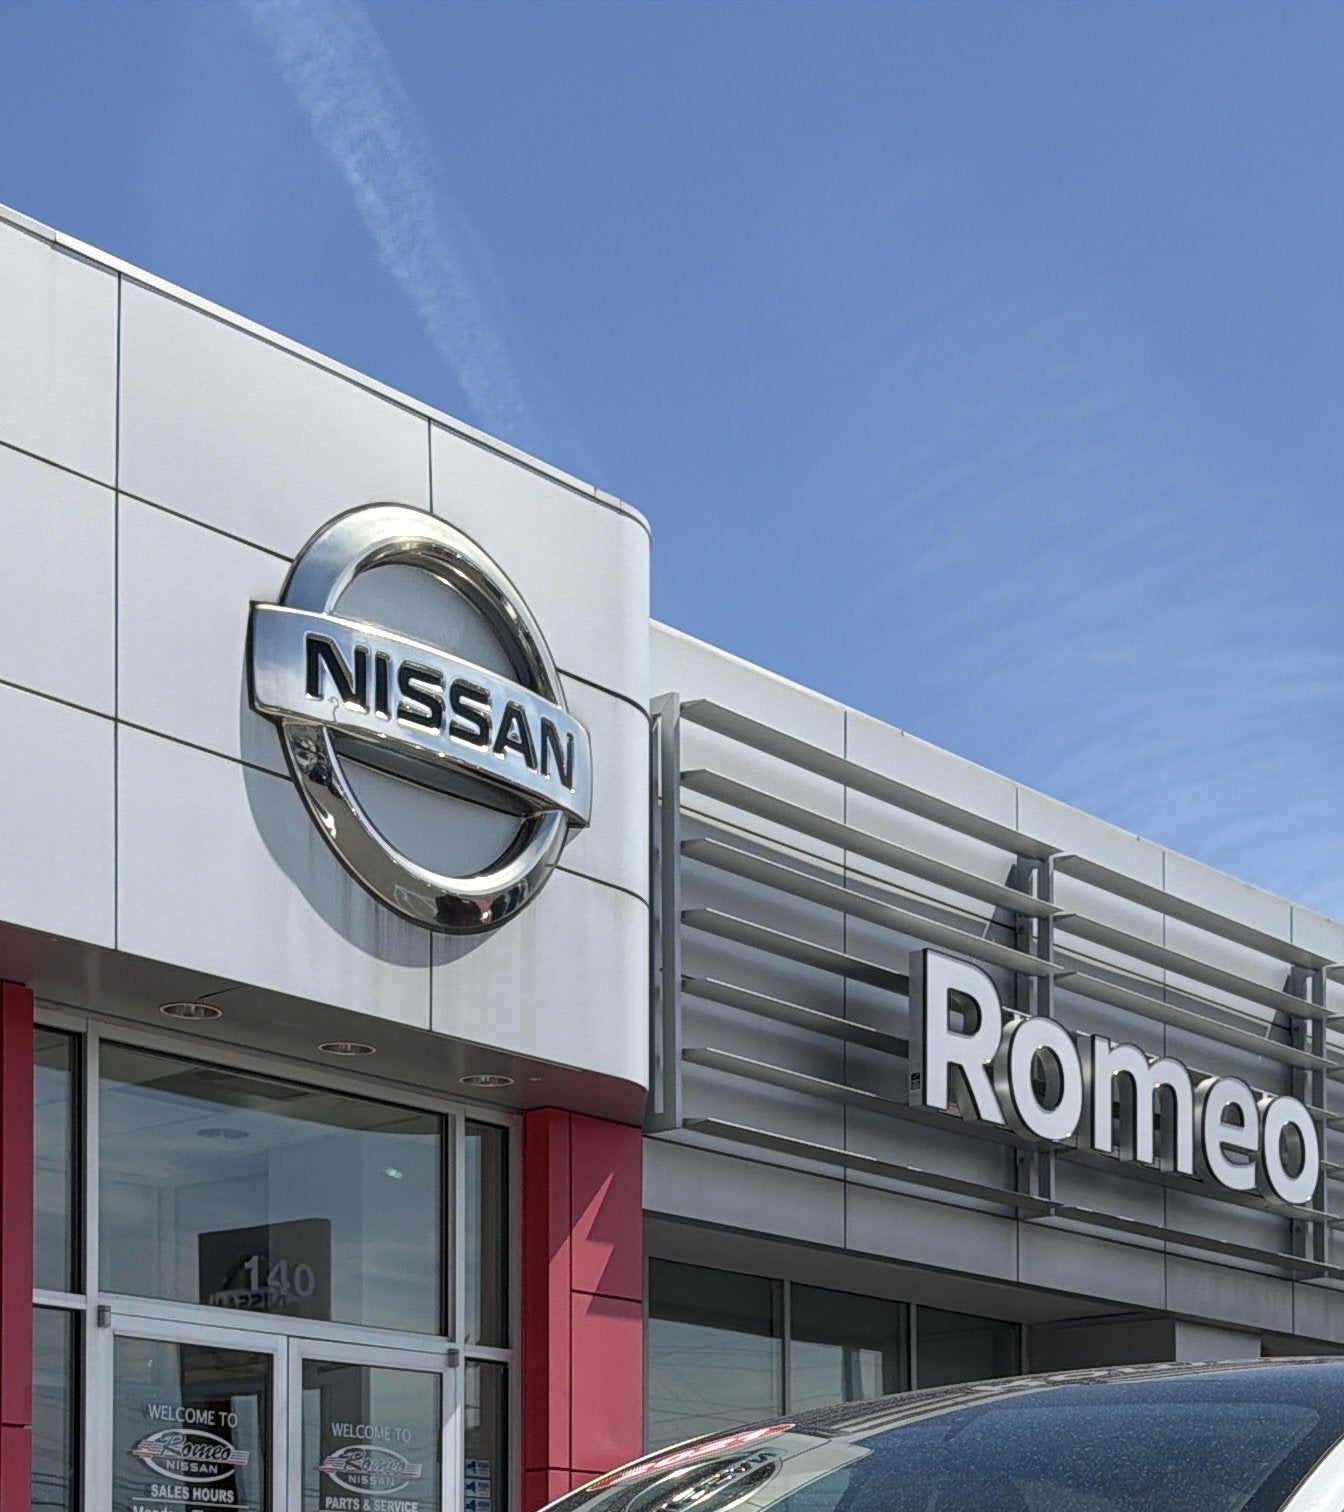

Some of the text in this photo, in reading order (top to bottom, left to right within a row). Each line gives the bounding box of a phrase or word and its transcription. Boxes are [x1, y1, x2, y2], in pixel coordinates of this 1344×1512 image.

[305, 632, 577, 795] NISSAN
[918, 948, 1320, 1204] Romeo
[244, 1255, 316, 1298] 140
[148, 1403, 238, 1428] WELCOME TO
[331, 1422, 411, 1443] WELCOME TO
[156, 1432, 233, 1461] Romeo
[166, 1460, 218, 1474] NISSAN
[342, 1448, 406, 1473] Romeo
[151, 1483, 234, 1503] SALES HOURS
[348, 1475, 395, 1486] NISSAN
[325, 1497, 360, 1511] PARTS
[362, 1499, 371, 1511] &
